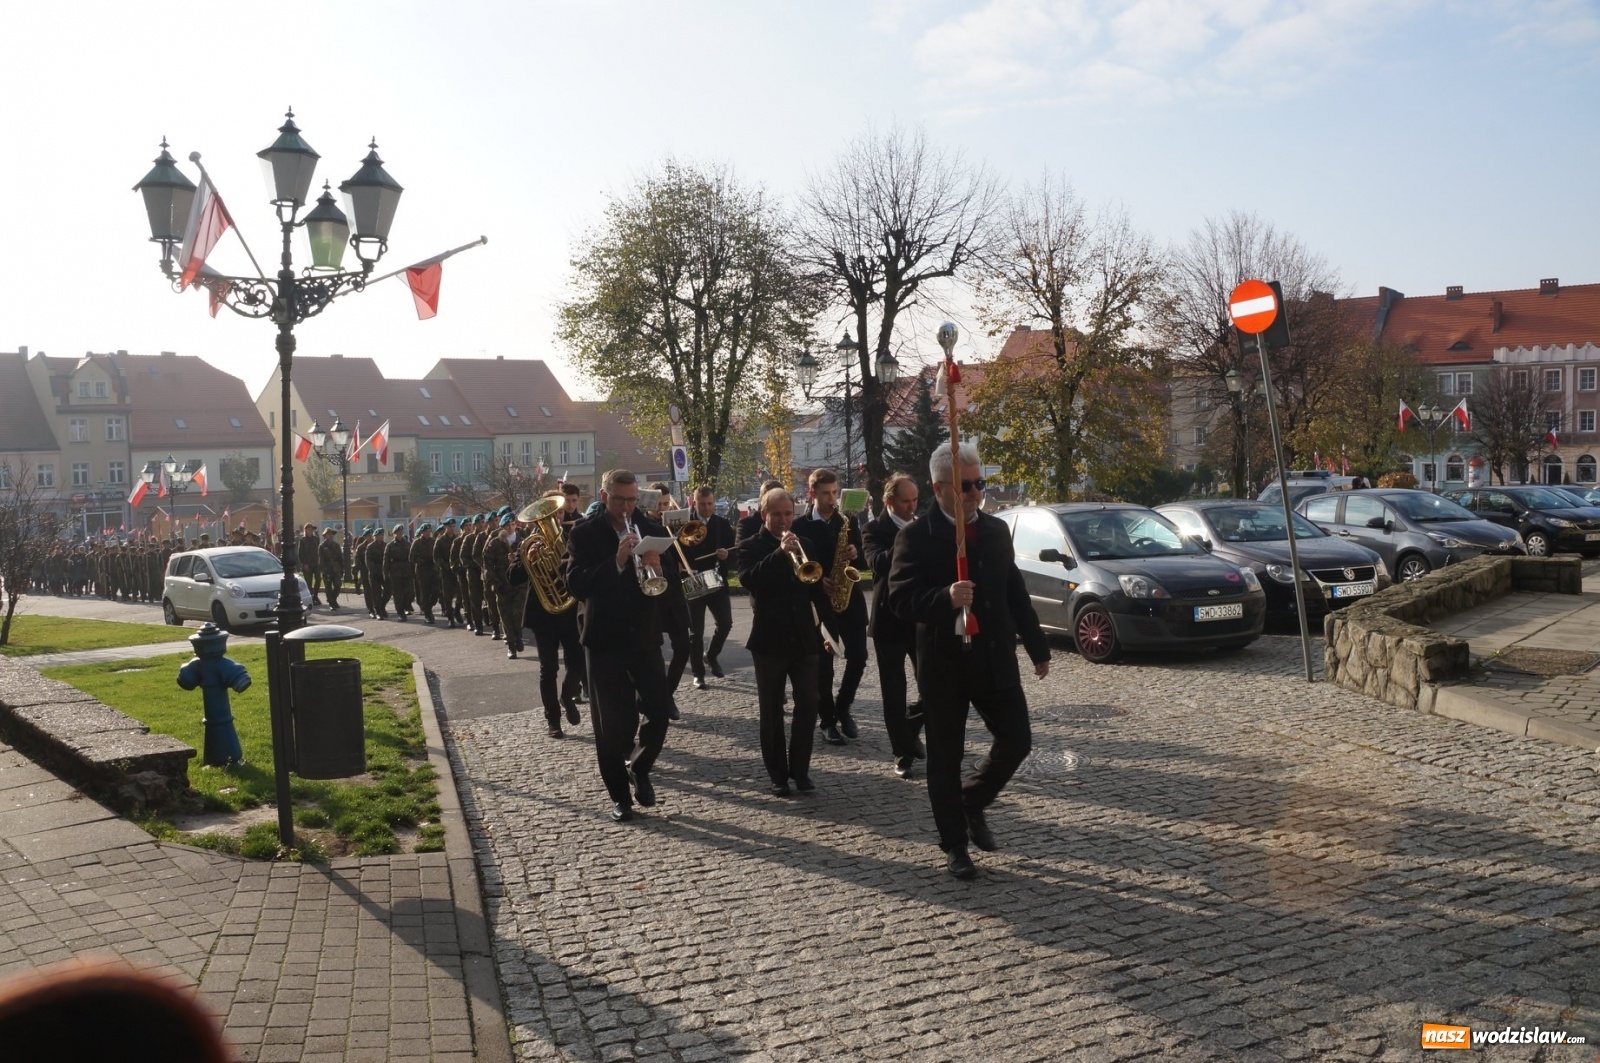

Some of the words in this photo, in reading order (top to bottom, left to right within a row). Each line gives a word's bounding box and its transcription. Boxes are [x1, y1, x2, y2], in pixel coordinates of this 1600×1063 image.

[1338, 587, 1351, 596] SWD
[1200, 607, 1215, 619] SWD
[1218, 604, 1242, 616] 33862
